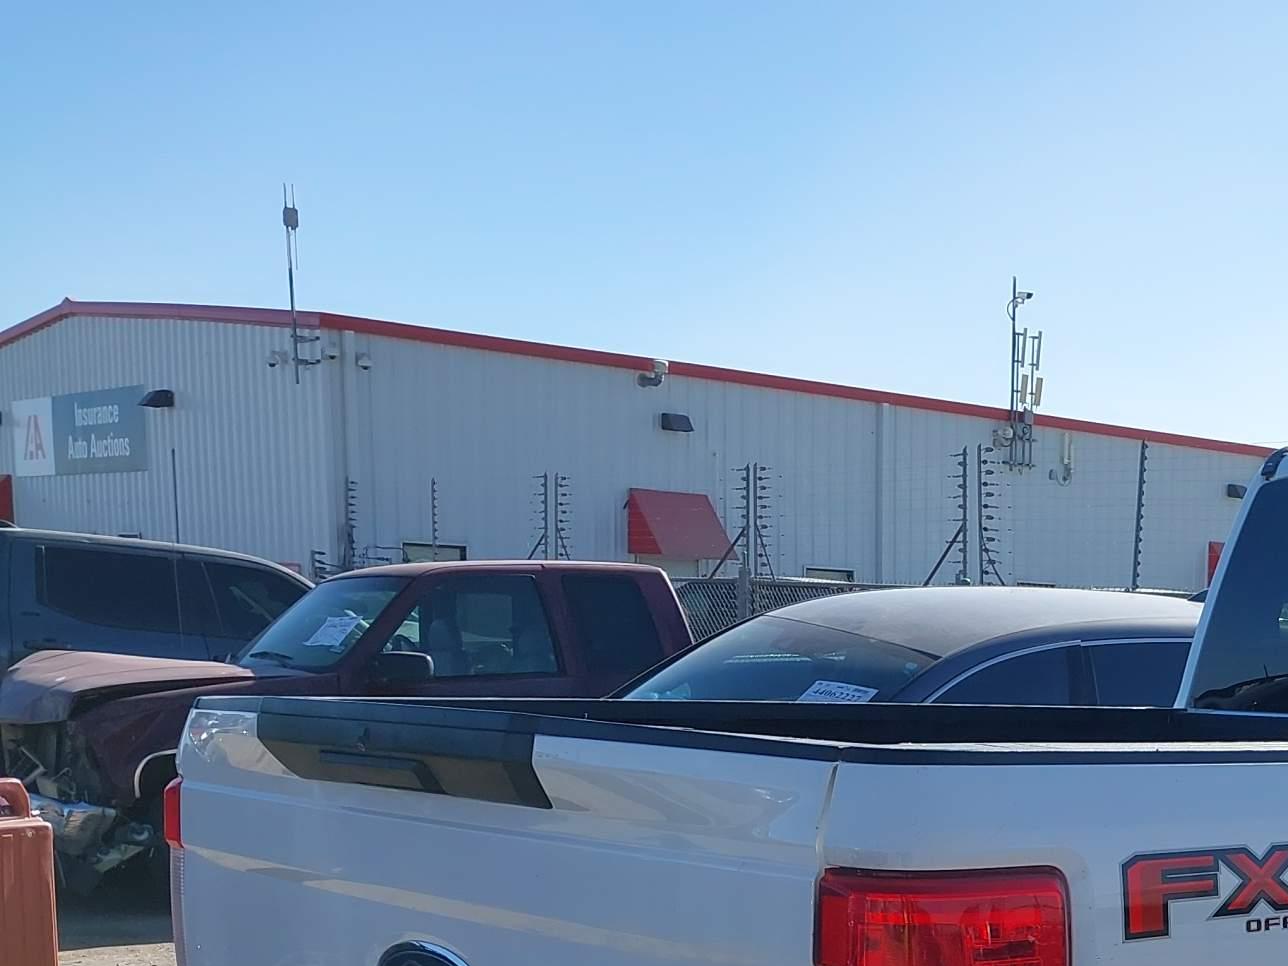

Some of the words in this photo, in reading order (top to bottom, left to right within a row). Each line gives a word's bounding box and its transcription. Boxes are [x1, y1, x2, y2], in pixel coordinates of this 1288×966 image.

[74, 402, 119, 427] Insurance
[68, 435, 88, 459] Auto
[90, 433, 130, 458] Auctions
